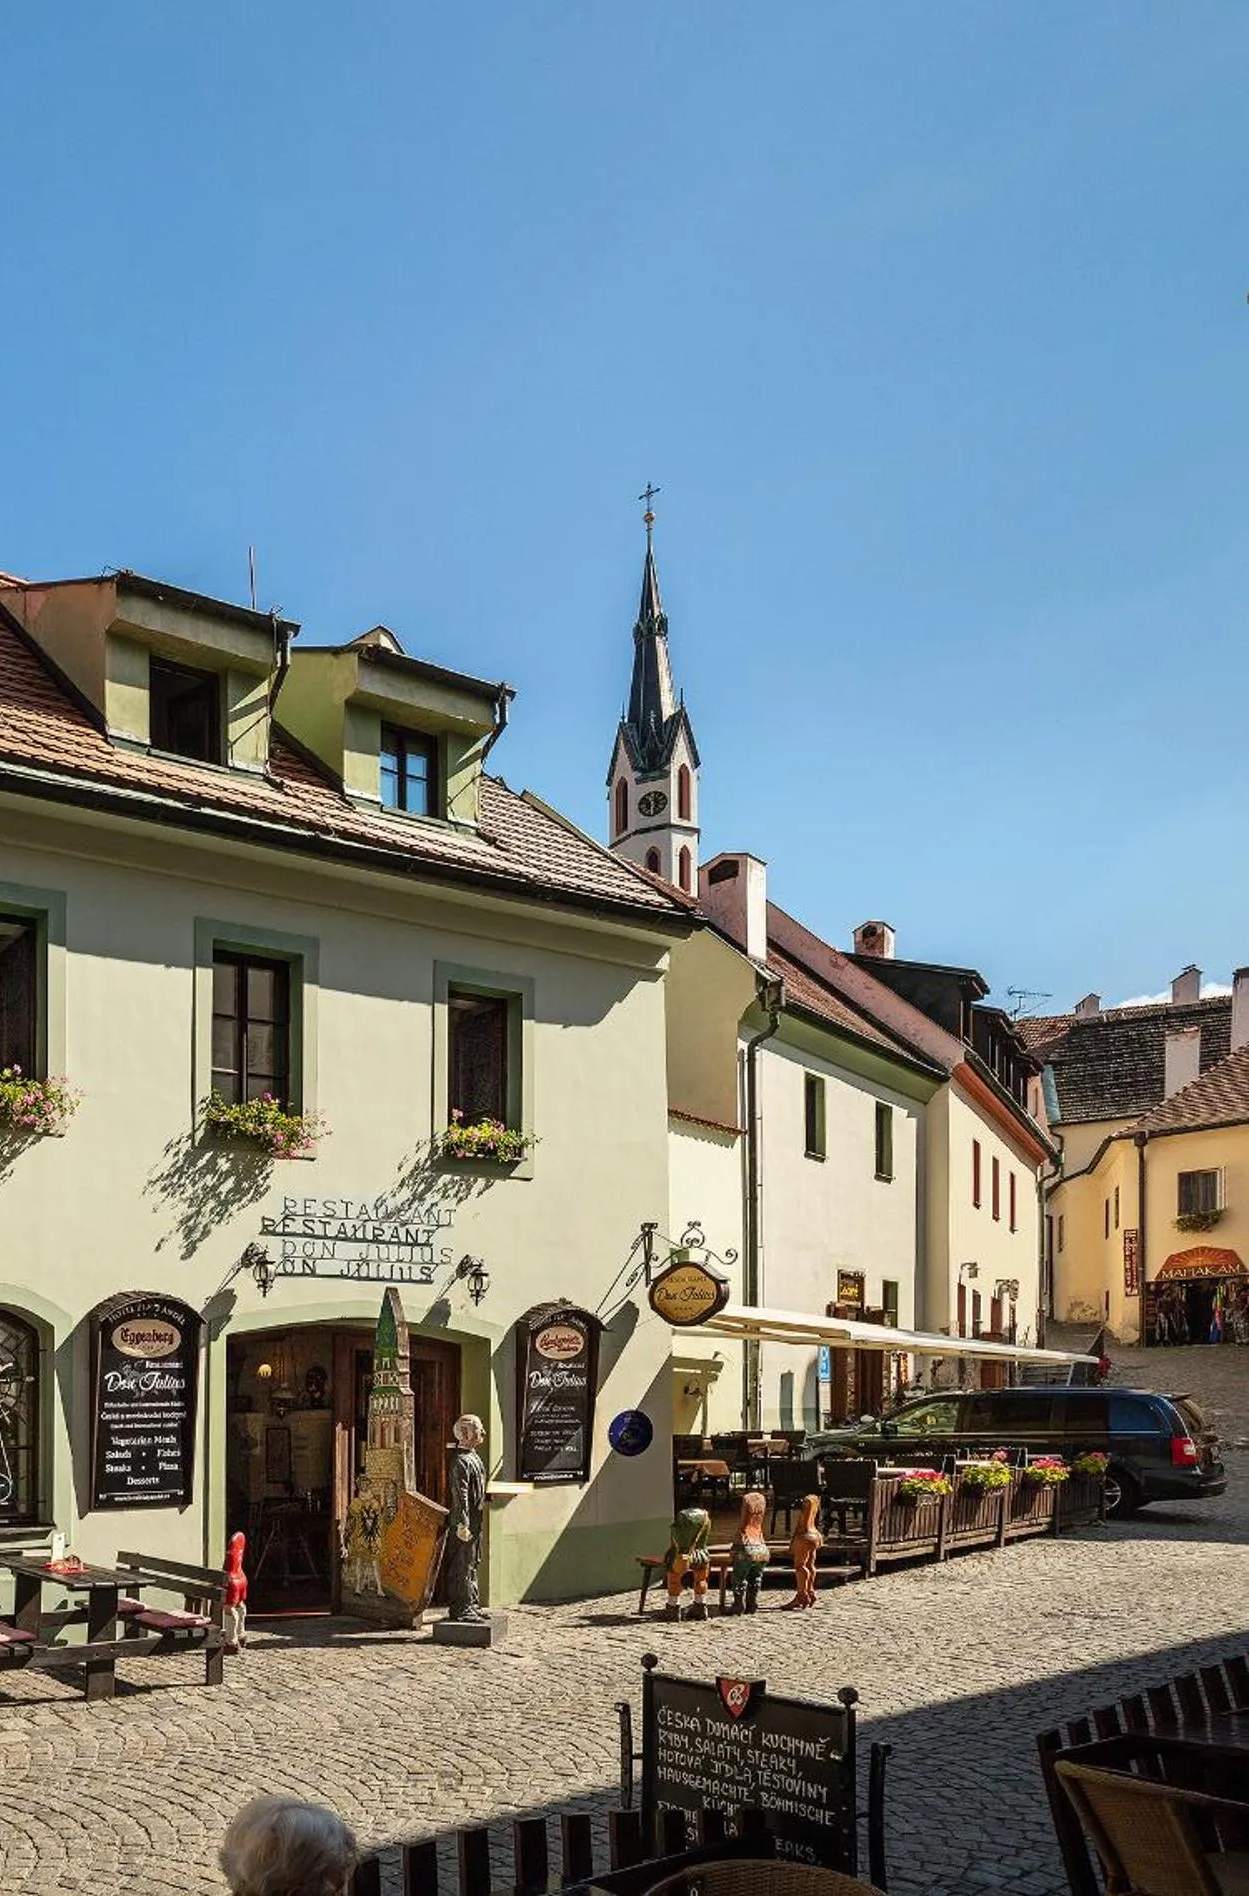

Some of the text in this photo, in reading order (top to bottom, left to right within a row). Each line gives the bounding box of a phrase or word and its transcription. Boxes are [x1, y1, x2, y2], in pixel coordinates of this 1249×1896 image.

[281, 1239, 454, 1264] DON JULIUS
[120, 1327, 174, 1346] Eggenberg
[104, 1371, 185, 1392] Don Julius
